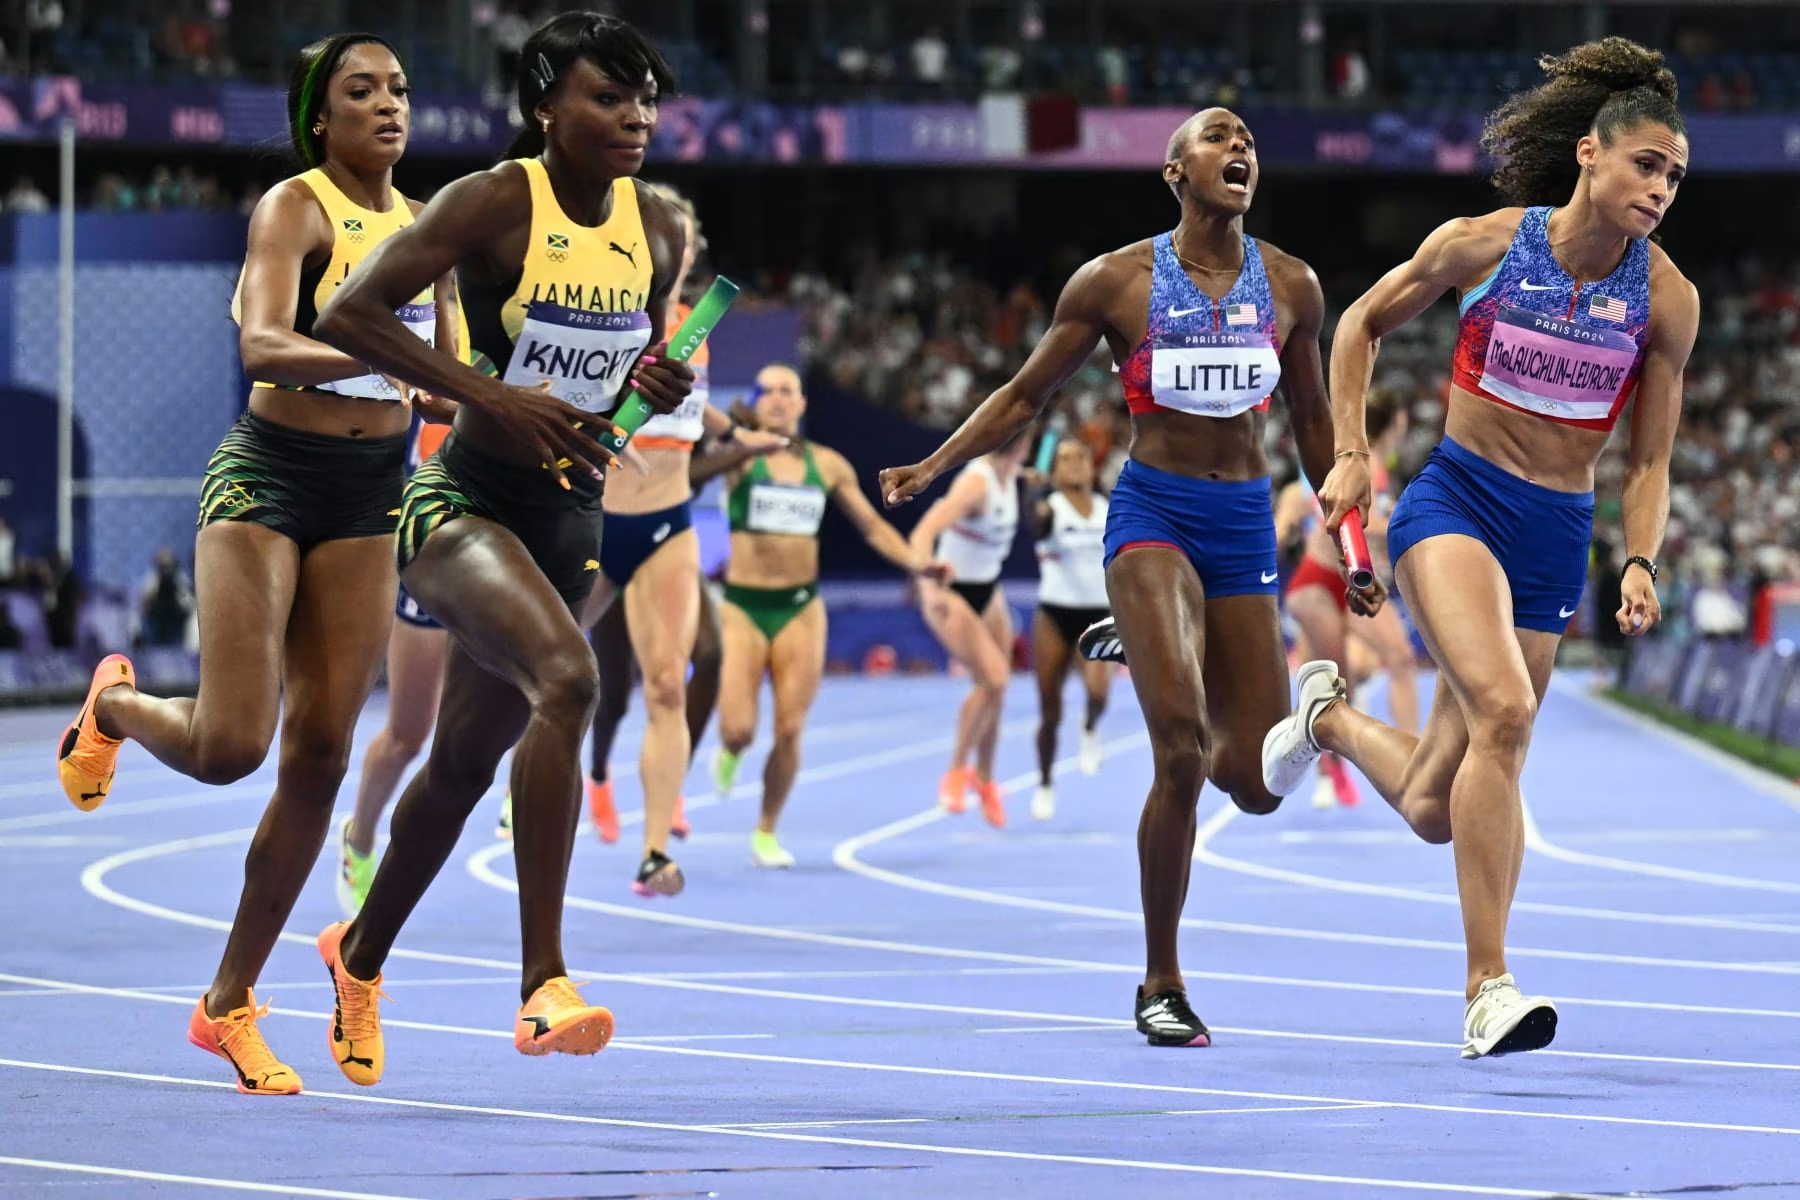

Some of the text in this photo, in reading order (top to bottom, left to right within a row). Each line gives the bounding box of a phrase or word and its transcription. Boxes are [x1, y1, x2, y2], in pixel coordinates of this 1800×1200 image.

[521, 283, 642, 313] JAMAICA
[568, 312, 632, 327] PARIS 2024
[1534, 318, 1605, 343] PARIS 2024
[674, 327, 707, 360] 024
[1185, 335, 1246, 344] PARIS 2024
[523, 340, 640, 381] KNIGHT
[1175, 364, 1262, 391] LITTLE
